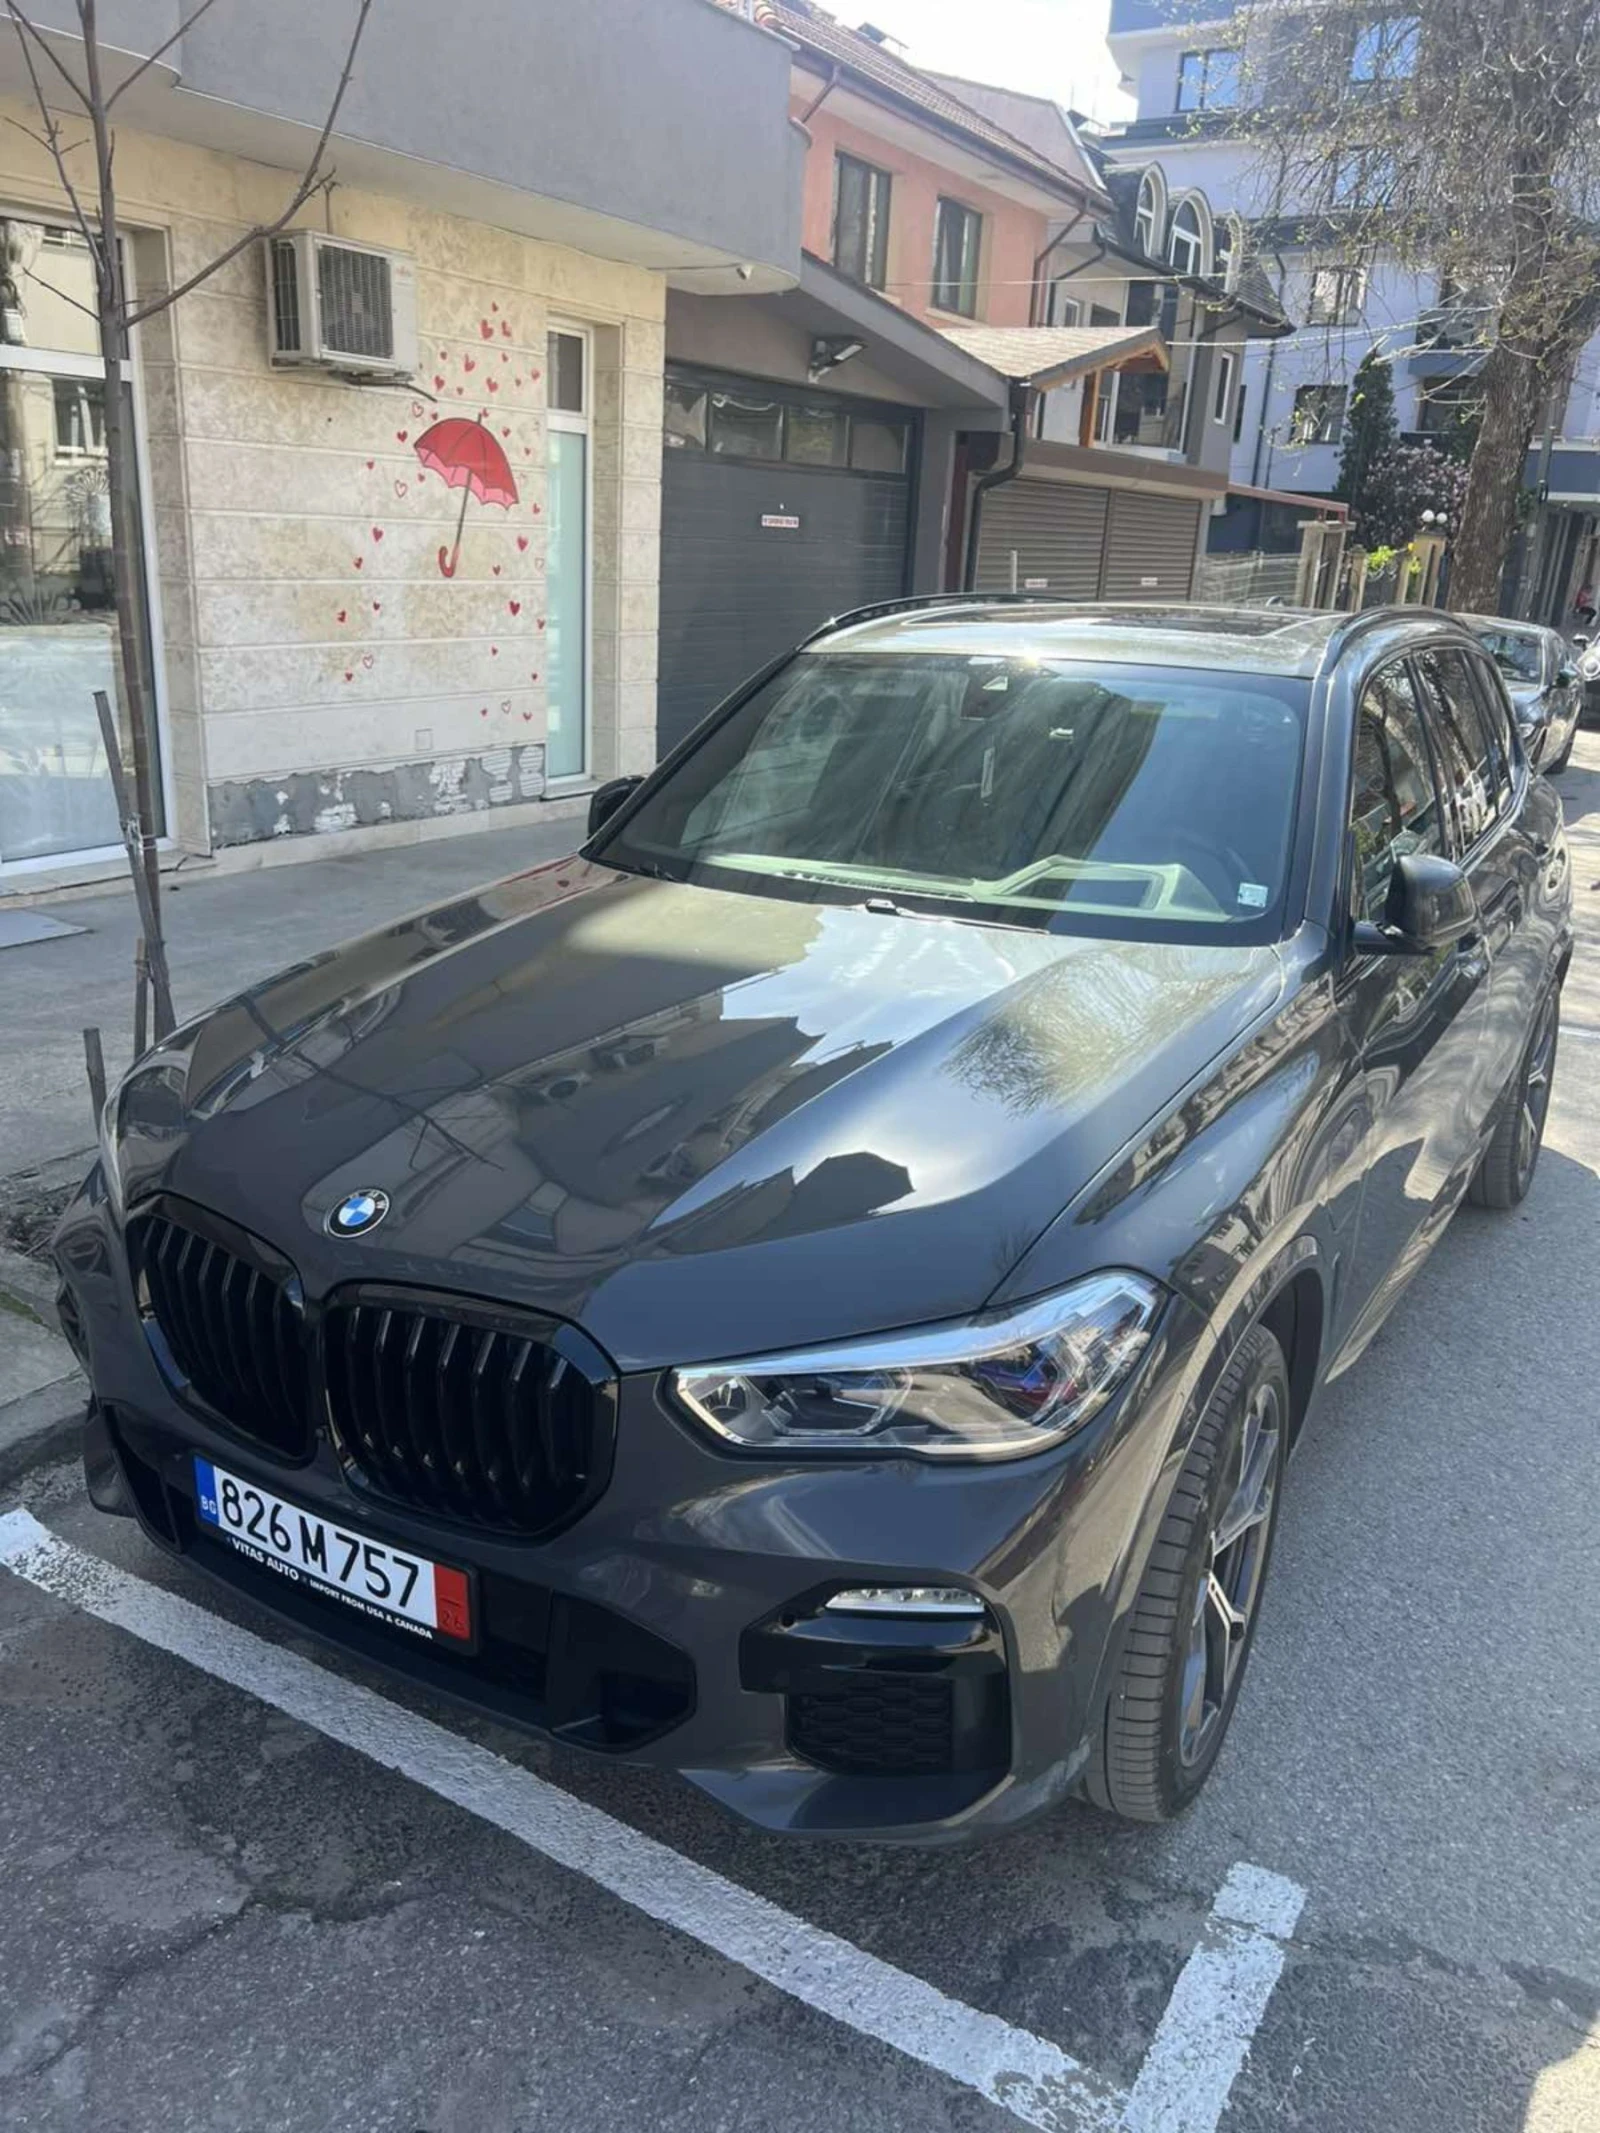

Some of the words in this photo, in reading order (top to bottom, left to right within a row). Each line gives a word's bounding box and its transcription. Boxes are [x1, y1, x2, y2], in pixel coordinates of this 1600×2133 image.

[200, 1494, 217, 1515] BG
[231, 1537, 265, 1563] VITAS
[266, 1556, 300, 1581] AUTO
[309, 1579, 340, 1600] IMPORT
[341, 1594, 366, 1611] FROM
[366, 1605, 385, 1619] USA
[394, 1618, 434, 1640] CANADA
